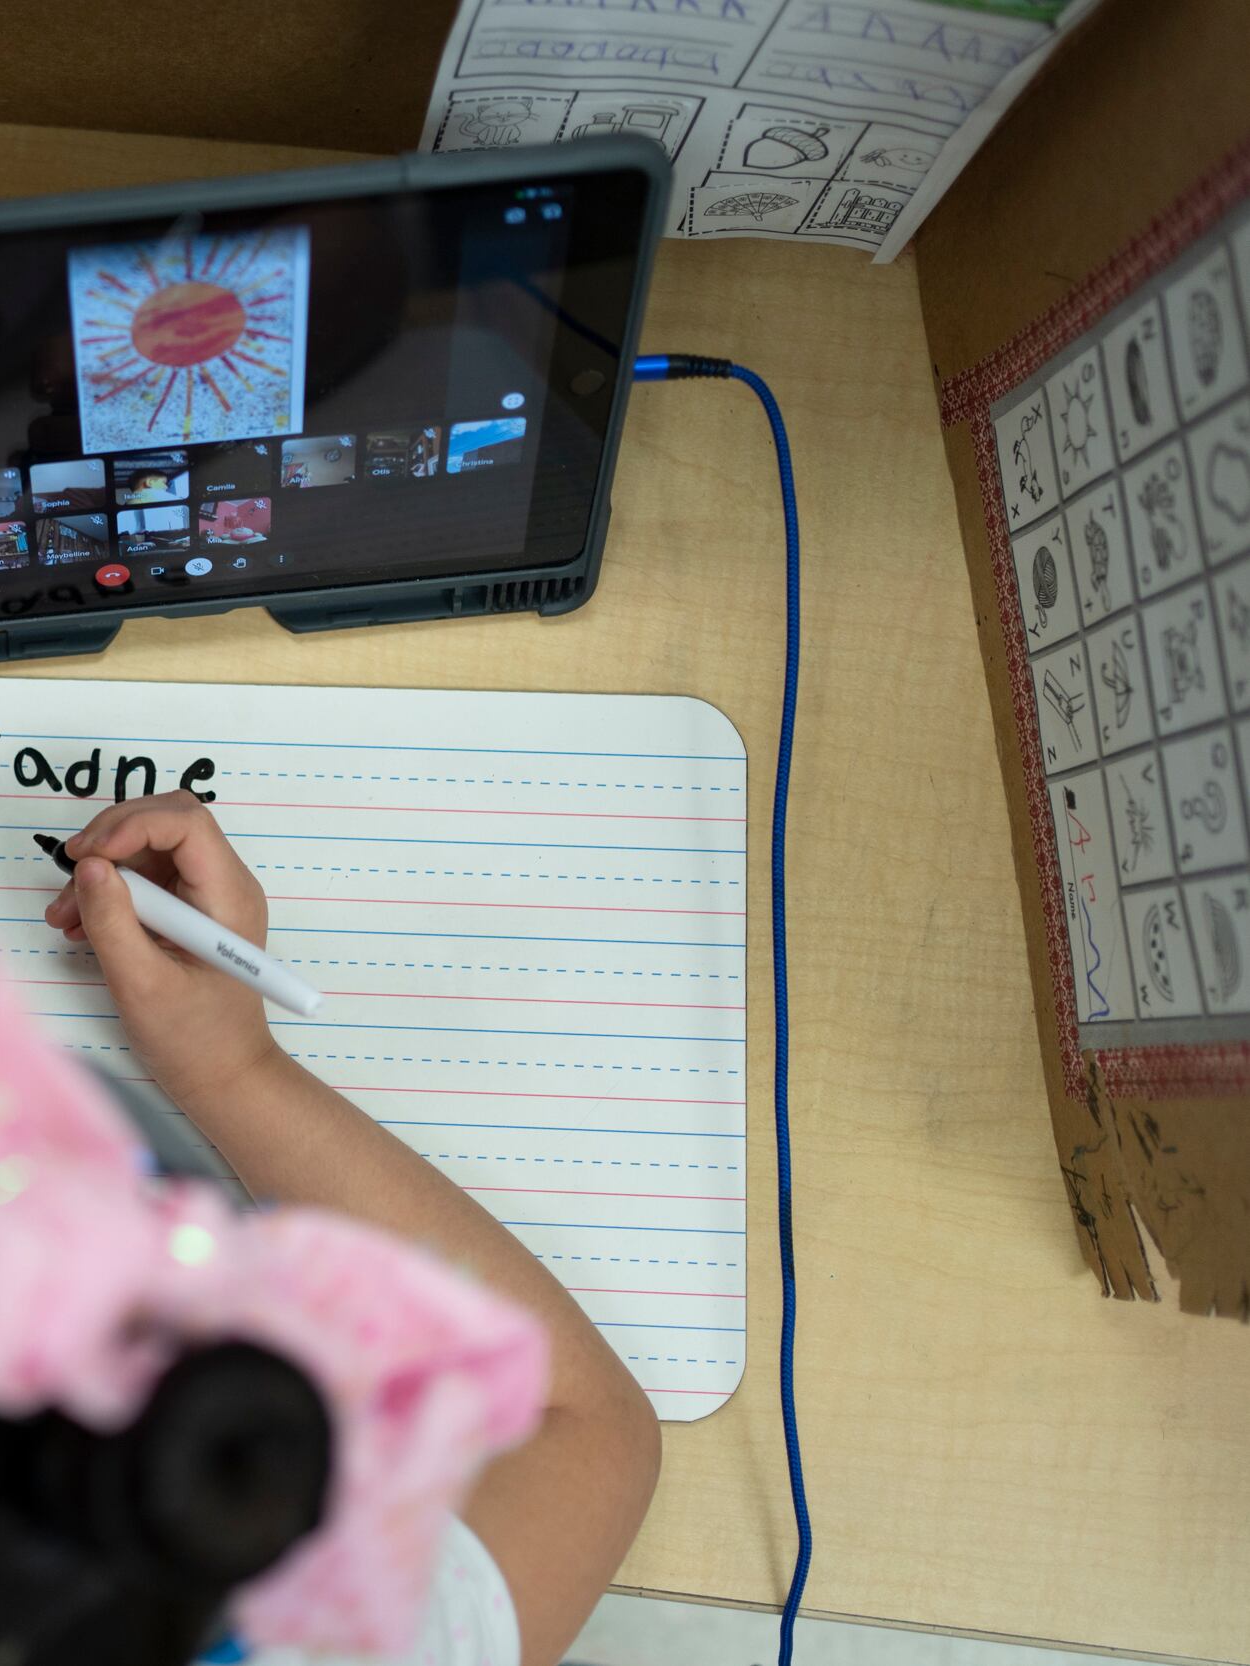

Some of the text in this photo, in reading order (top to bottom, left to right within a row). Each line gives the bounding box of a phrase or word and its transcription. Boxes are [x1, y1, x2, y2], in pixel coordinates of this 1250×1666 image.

[1081, 362, 1095, 383] S
[1031, 404, 1043, 424] X
[372, 468, 391, 476] Otis
[1165, 456, 1182, 482] O
[206, 484, 236, 493] Camila
[41, 500, 70, 509] Sophia
[1102, 493, 1117, 519] T
[46, 550, 91, 560] Maybelline
[127, 545, 149, 553] Adan
[1121, 628, 1135, 650] U
[1069, 653, 1082, 678] Z
[1141, 763, 1155, 785] V
[1067, 881, 1076, 921] Name
[1164, 900, 1181, 931] W
